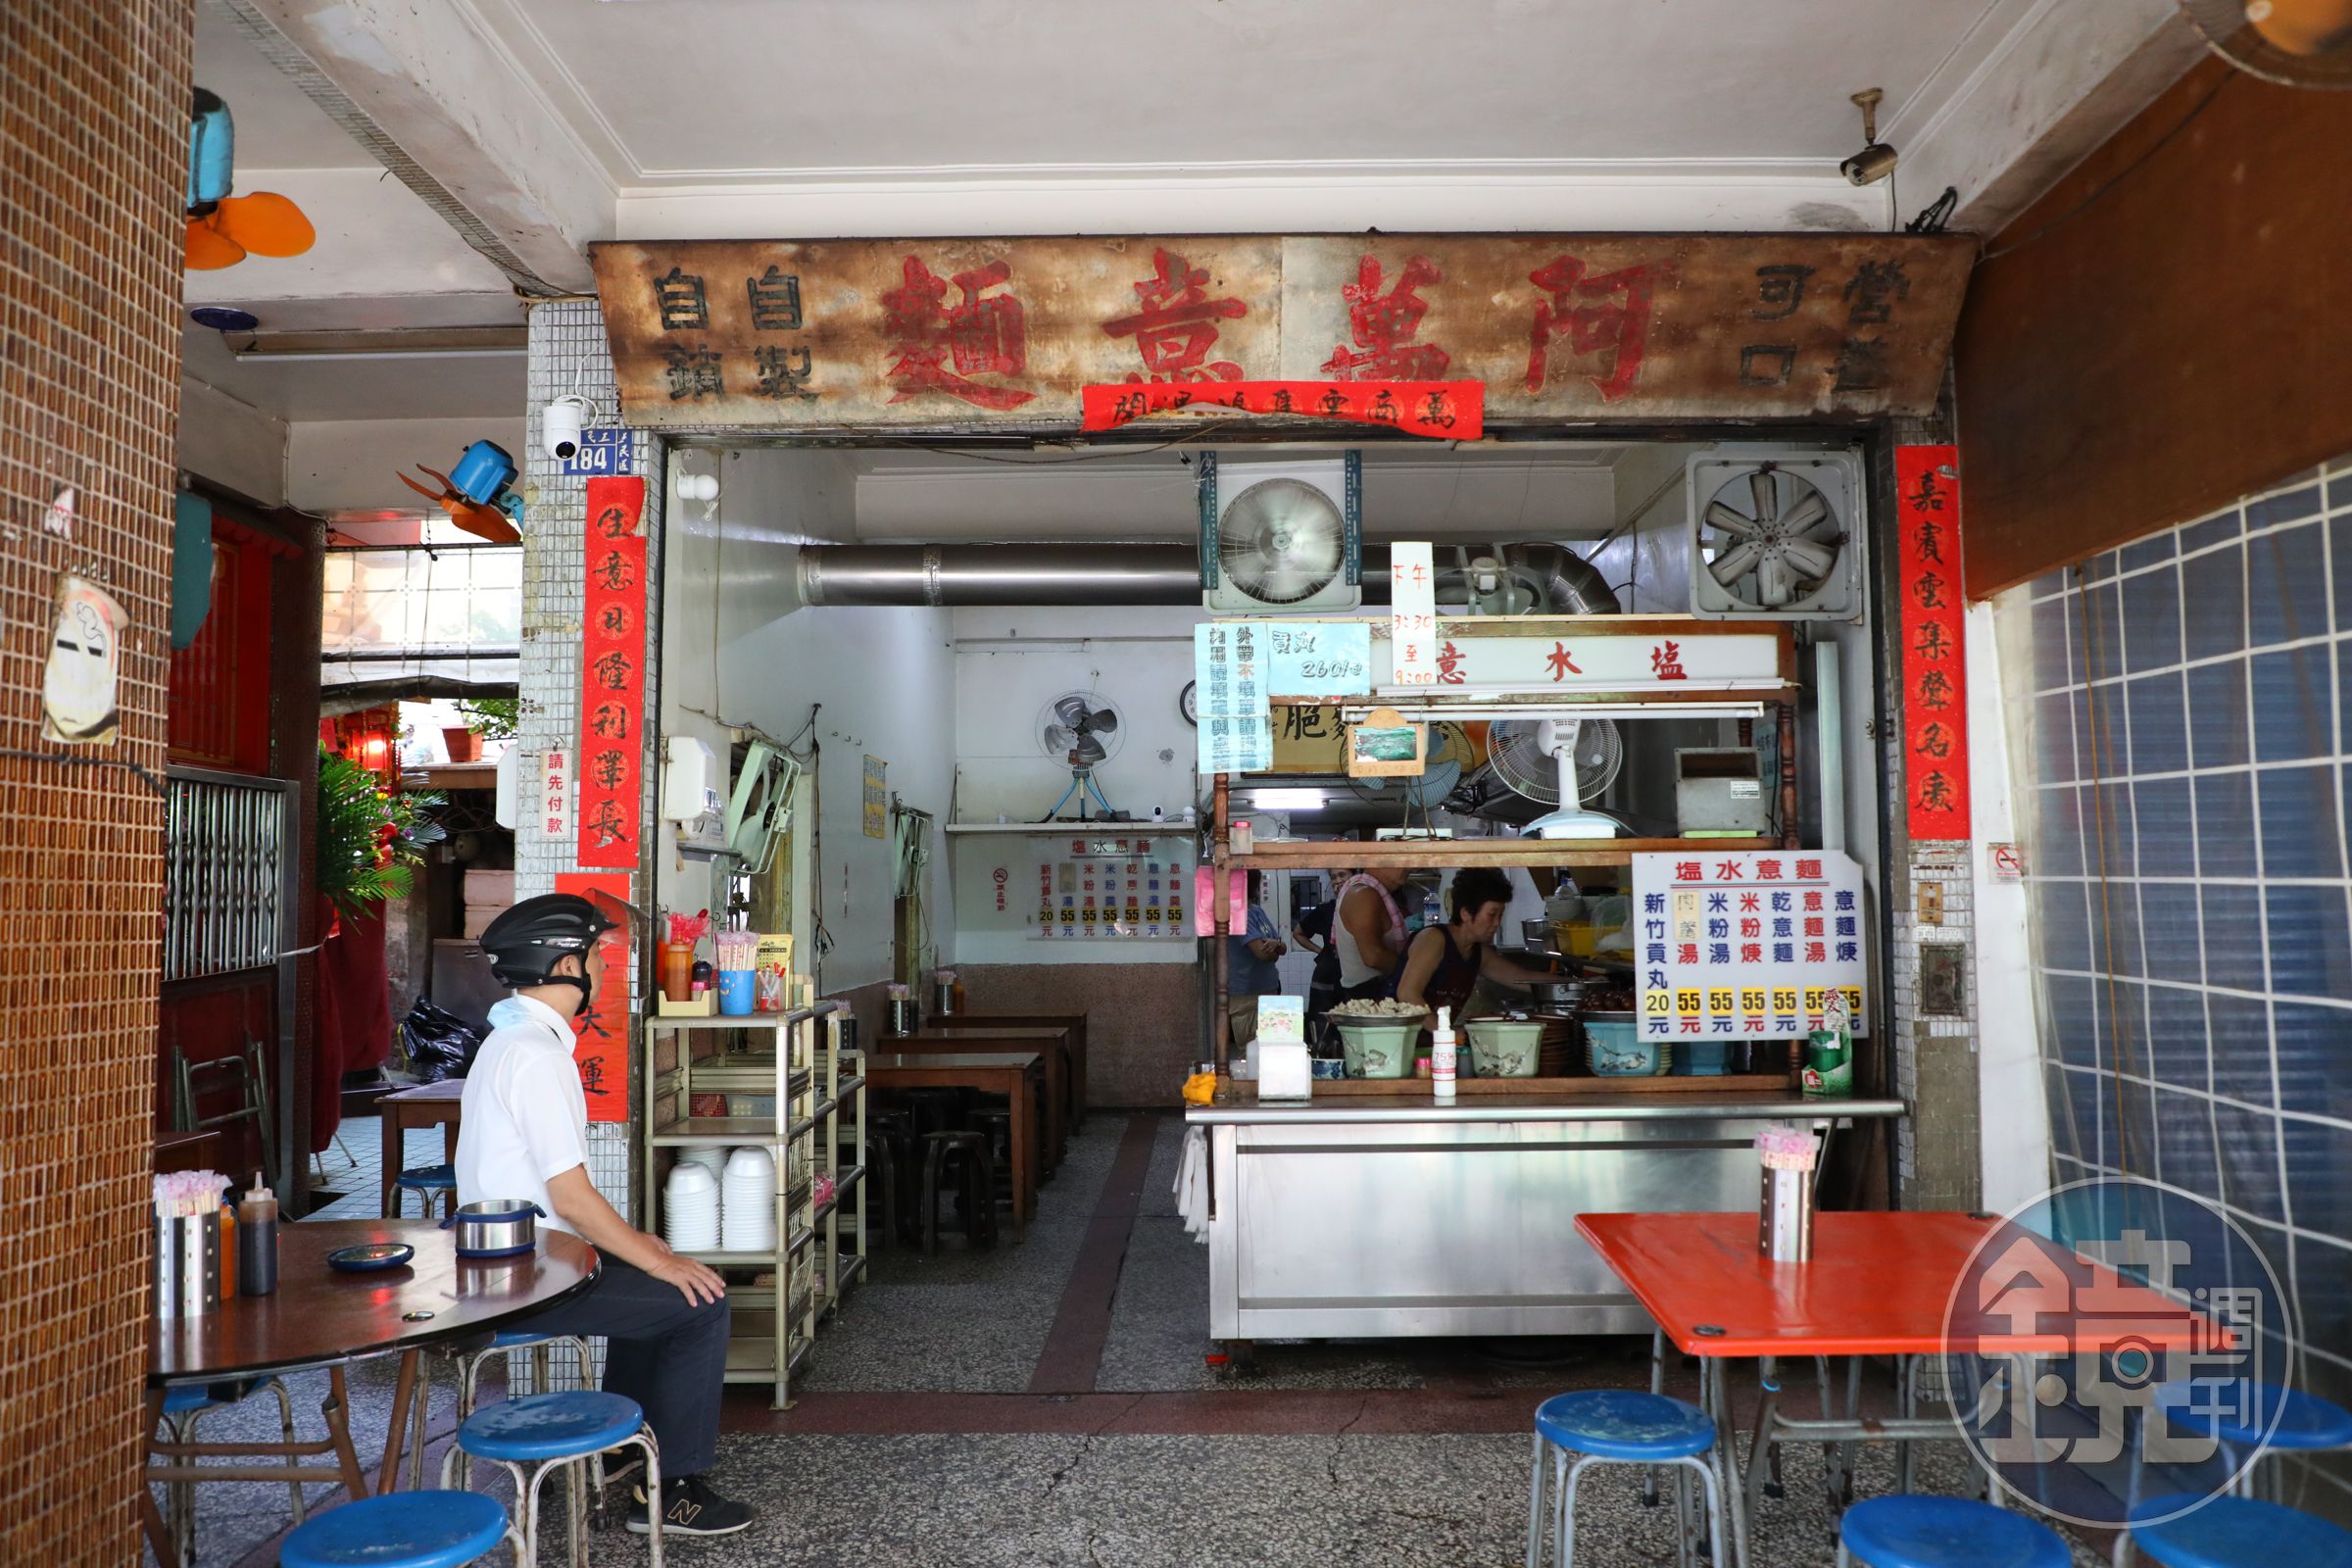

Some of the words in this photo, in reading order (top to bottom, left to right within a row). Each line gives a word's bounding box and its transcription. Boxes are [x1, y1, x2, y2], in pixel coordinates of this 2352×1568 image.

[1393, 564, 1428, 589] 下午
[1394, 614, 1433, 630] 3:30
[1405, 644, 1419, 662] 至
[1396, 672, 1433, 686] 9:00
[547, 753, 564, 835] 請先付款
[1675, 859, 1823, 881] 塩水意麵
[1040, 911, 1054, 921] 20
[1060, 909, 1075, 921] 55
[1082, 909, 1097, 921] 55
[1102, 909, 1117, 921] 55
[1125, 909, 1139, 921] 55
[1146, 908, 1160, 920] 55
[1167, 908, 1182, 921] 55
[1708, 892, 1730, 963] 米粉湯
[1771, 892, 1794, 963] 乾意麵
[1803, 891, 1826, 962] 意麵湯
[1644, 893, 1668, 990] 新竹貢丸
[1646, 995, 1669, 1011] 20
[1678, 992, 1700, 1010] 55
[1710, 992, 1733, 1010] 55
[1742, 992, 1765, 1010] 55
[1773, 992, 1795, 1009] 55
[1648, 1016, 1669, 1034] 元
[1680, 1016, 1701, 1033] 元
[1712, 1016, 1733, 1033] 元
[1743, 1015, 1765, 1032] 元
[1775, 1015, 1796, 1032] 元
[667, 1498, 703, 1525] N
